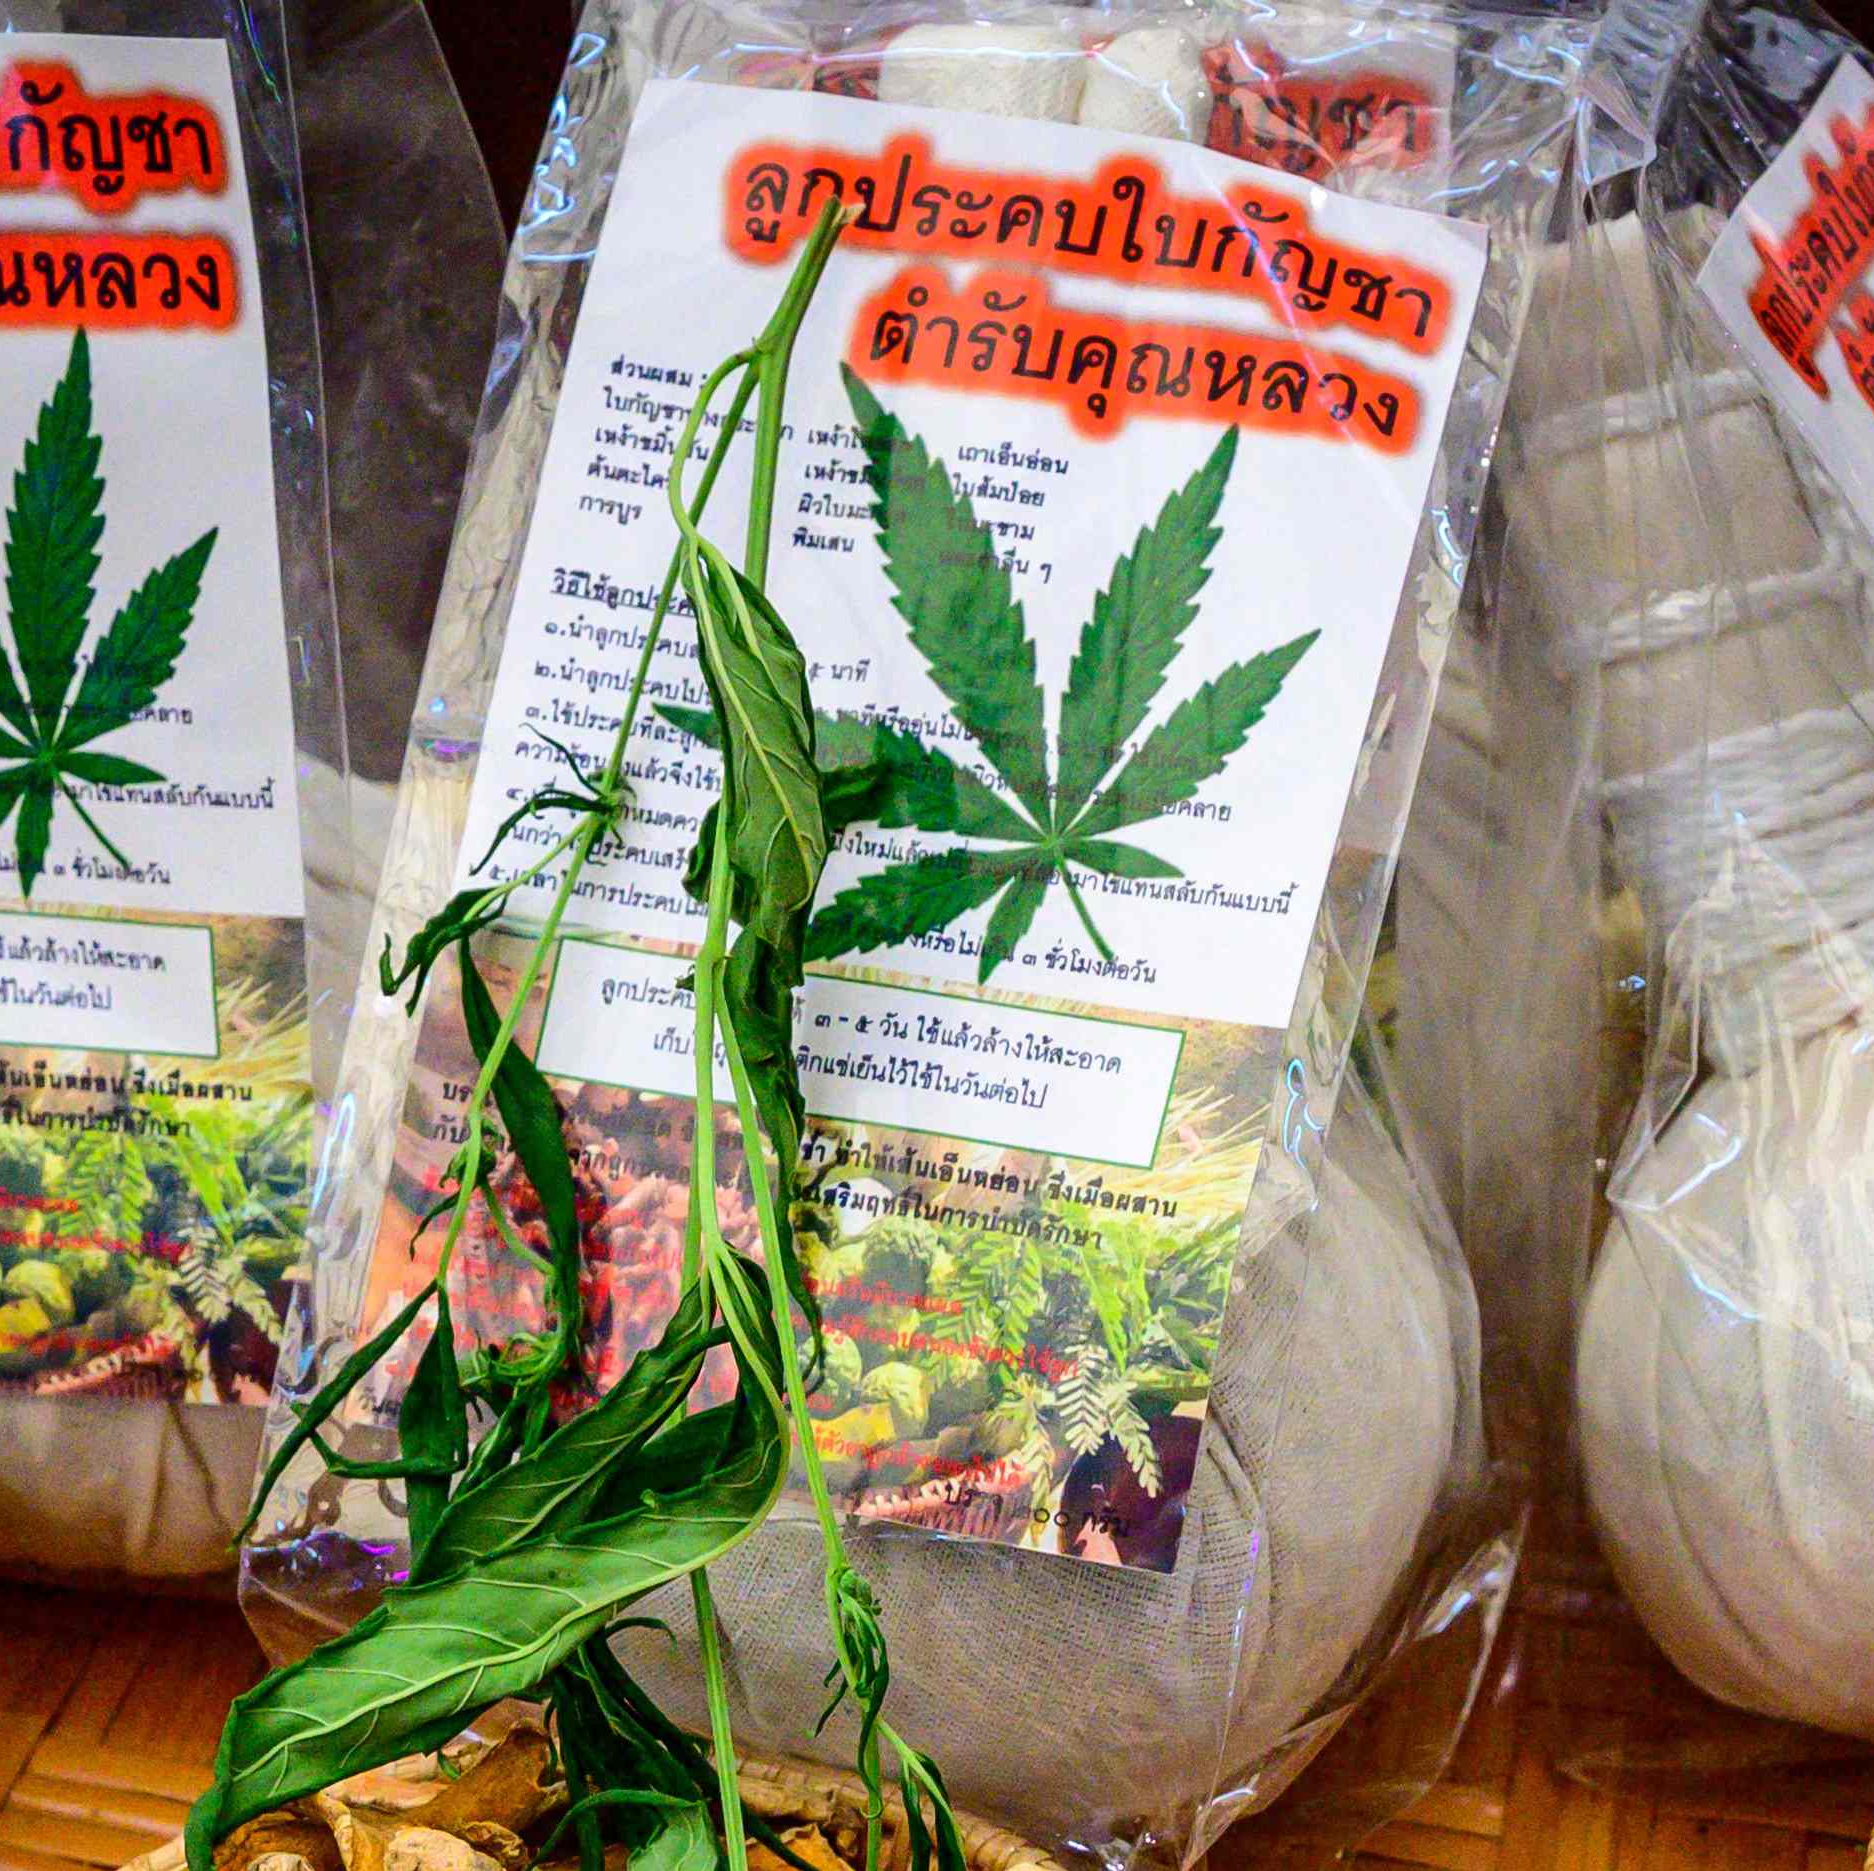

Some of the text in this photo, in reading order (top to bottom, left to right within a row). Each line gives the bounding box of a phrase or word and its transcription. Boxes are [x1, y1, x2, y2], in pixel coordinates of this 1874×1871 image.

[742, 153, 1437, 341] ลูกประคบใบกัญชา
[609, 355, 694, 388] ส่วนผสม
[870, 284, 1402, 440] ตำรับคุณหลวง
[957, 441, 1071, 477] เถาเอ็นอ่อน
[578, 491, 643, 527] การบูร
[791, 528, 855, 555] พิมเสน
[830, 658, 871, 683] นาที
[879, 1010, 909, 1042] วัน
[916, 1014, 1123, 1075] ใช้แล้วล้างให้สะอาด
